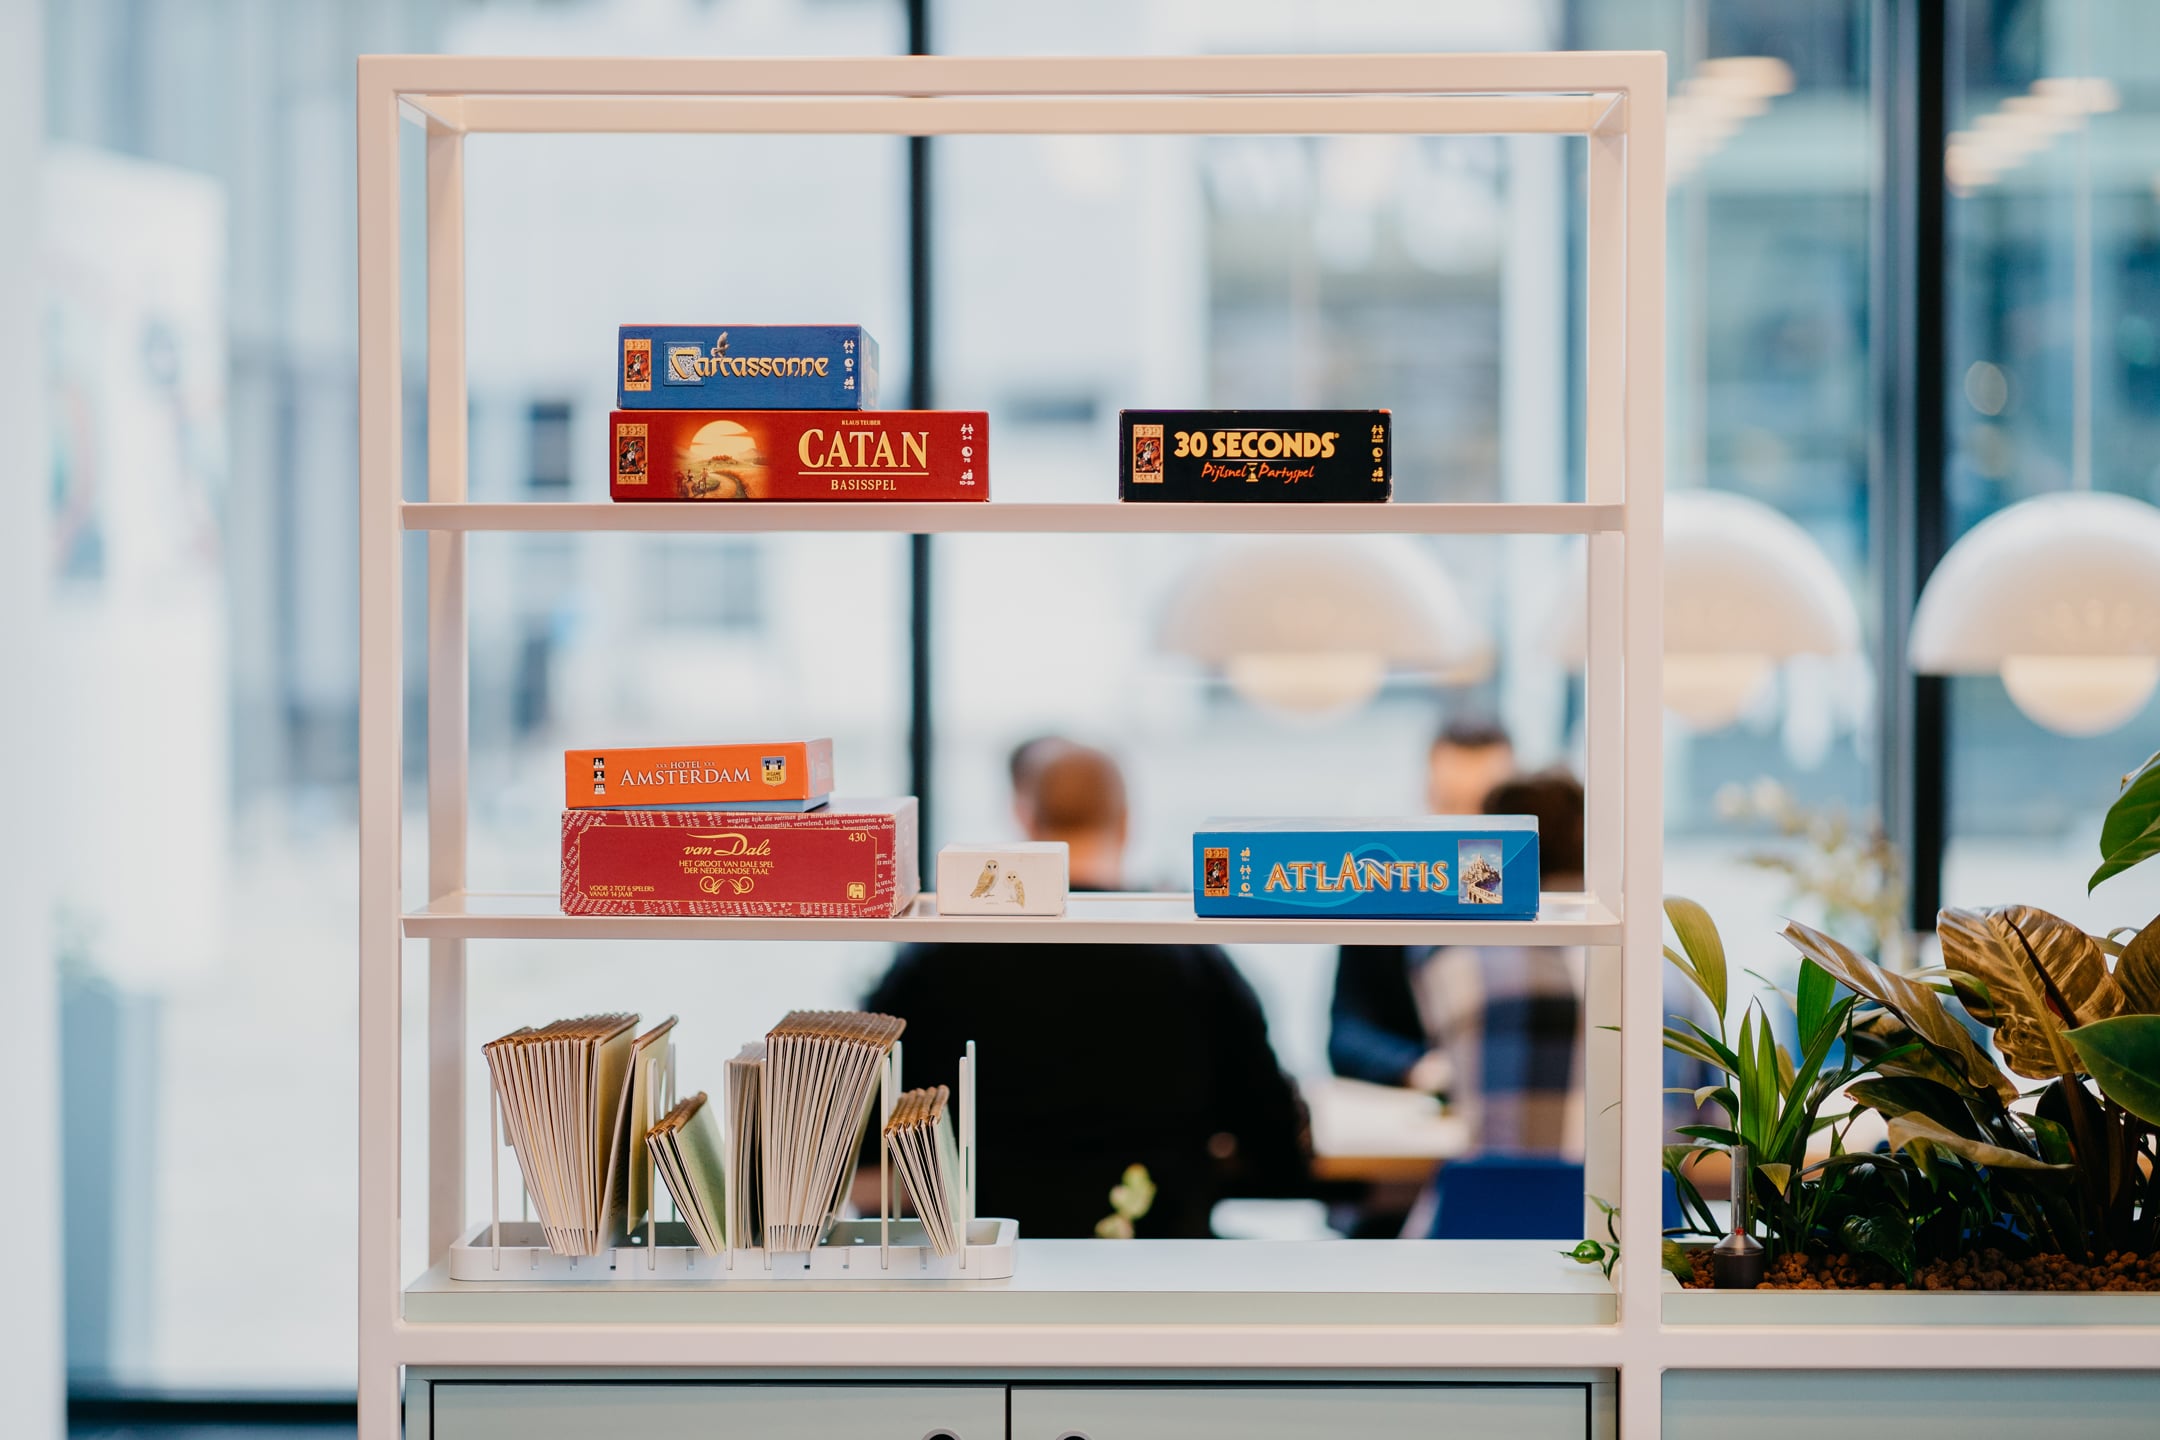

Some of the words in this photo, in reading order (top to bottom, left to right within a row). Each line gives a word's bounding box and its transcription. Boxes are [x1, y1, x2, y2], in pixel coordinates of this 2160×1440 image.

[671, 349, 829, 378] Carcassonne
[619, 426, 645, 435] 999
[1135, 426, 1161, 436] 999
[798, 429, 929, 469] CATAN
[1174, 431, 1208, 457] 30
[1201, 461, 1247, 482] Pijlsnel
[1258, 462, 1315, 484] Partyspel
[831, 480, 897, 490] BASISSPEL
[670, 761, 700, 769] HOTEL
[620, 767, 751, 786] AMSTERDAM
[694, 832, 771, 856] Dale
[848, 833, 866, 842] 430
[682, 846, 712, 855] van
[1205, 848, 1227, 857] 999
[1263, 852, 1449, 892] ATLANTIS
